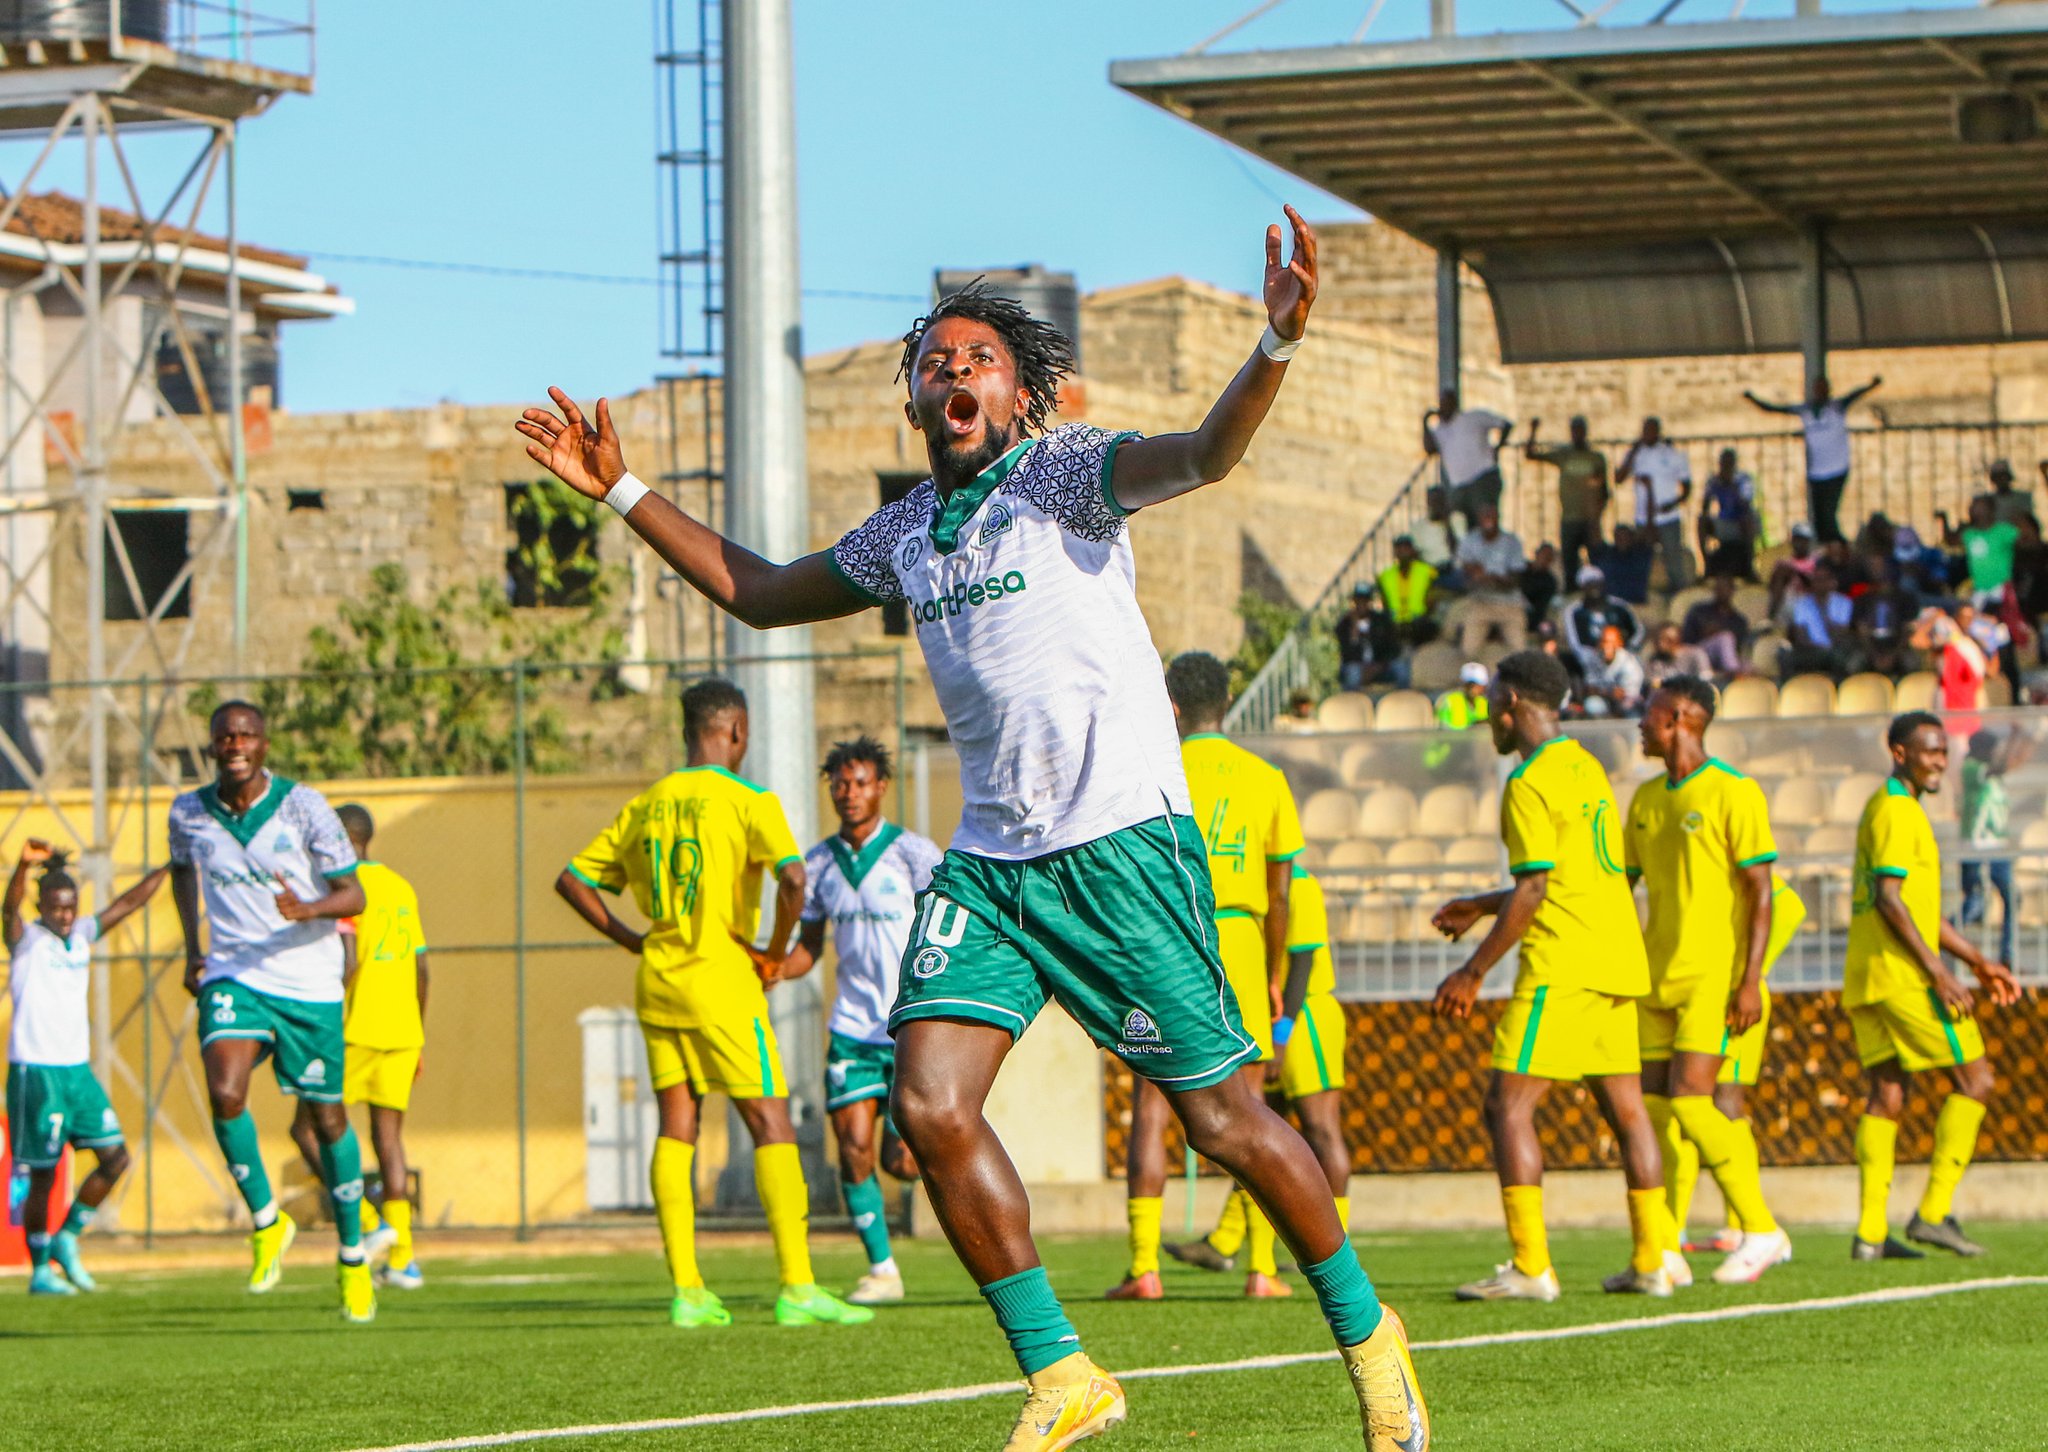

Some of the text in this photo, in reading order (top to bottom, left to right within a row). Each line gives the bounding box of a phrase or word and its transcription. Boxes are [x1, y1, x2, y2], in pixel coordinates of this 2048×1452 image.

[643, 837, 704, 918] 19
[373, 905, 411, 961] 25
[915, 891, 971, 948] 10
[1117, 1043, 1173, 1056] SportPesa
